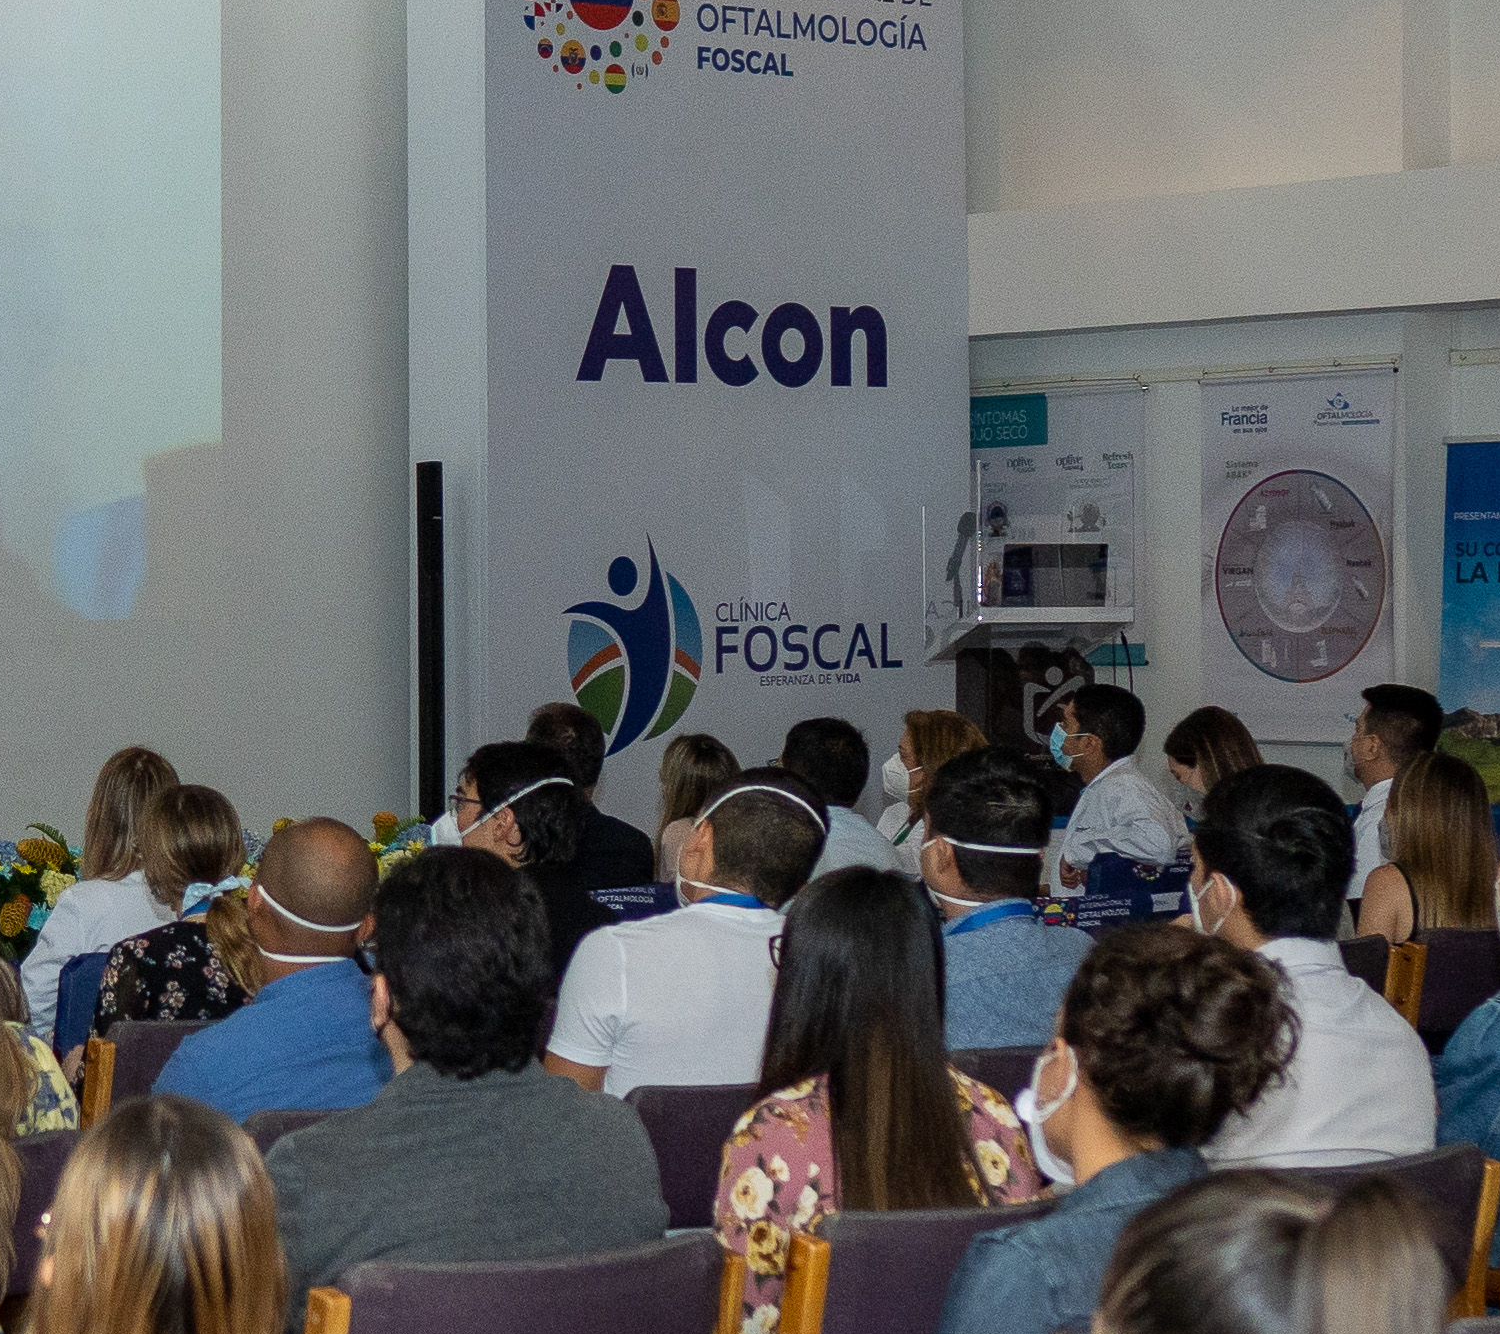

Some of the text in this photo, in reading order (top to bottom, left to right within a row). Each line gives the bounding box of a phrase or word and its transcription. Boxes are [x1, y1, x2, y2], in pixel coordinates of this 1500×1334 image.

[697, 2, 927, 51] OFTALMOLOGÍA
[697, 45, 793, 77] FOSCAL
[575, 264, 888, 388] Alcon
[1221, 411, 1268, 427] Francia
[997, 424, 1028, 441] SECO
[1455, 542, 1478, 557] SU
[1456, 562, 1489, 584] LA
[715, 596, 791, 623] CLÍNICA
[715, 622, 903, 674] FOSCAL
[759, 672, 861, 687] ESPERANZA DE VIDA
